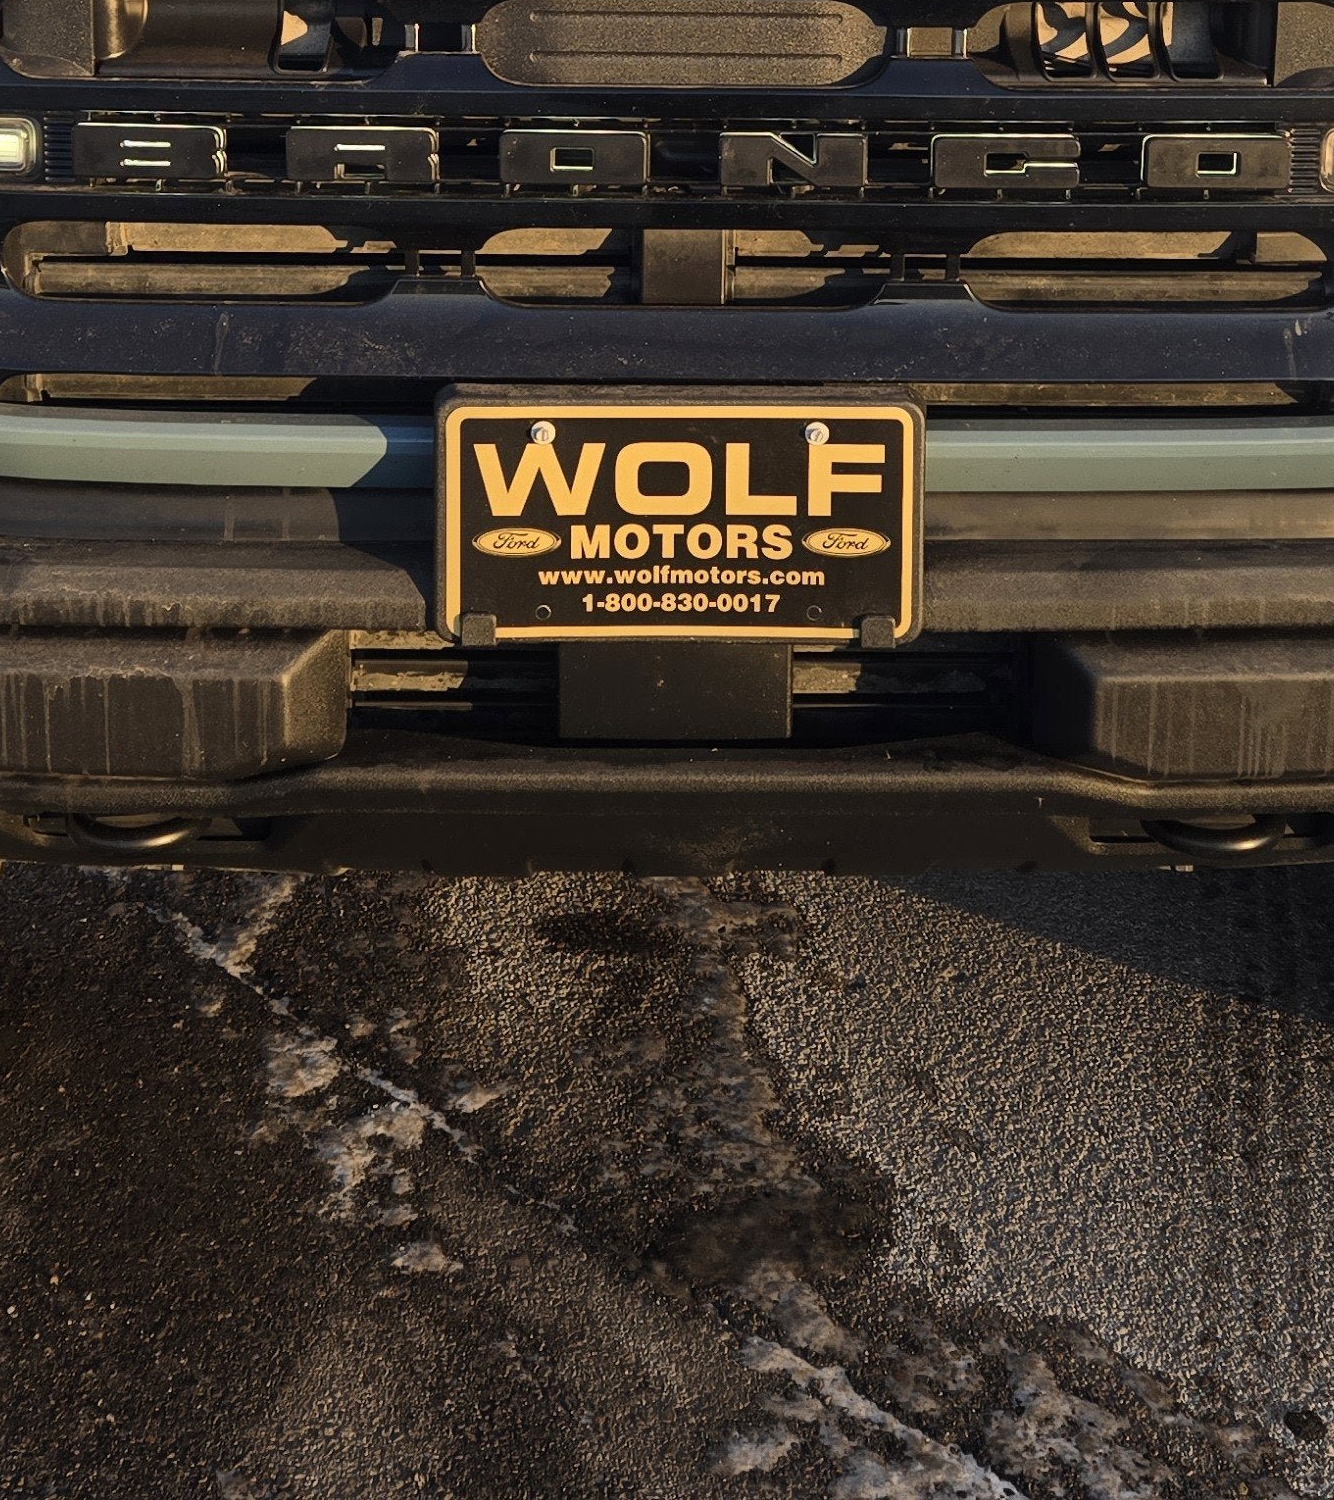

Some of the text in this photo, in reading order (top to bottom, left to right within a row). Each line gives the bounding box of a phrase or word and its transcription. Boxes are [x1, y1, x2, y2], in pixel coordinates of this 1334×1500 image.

[72, 122, 1291, 192] BRONCO
[473, 441, 886, 517] WOLF
[492, 531, 541, 550] Ford
[569, 522, 794, 561] MOTORS
[822, 531, 870, 550] Ford
[538, 565, 825, 587] www.wolfmotors.com
[581, 592, 781, 614] 1-800-830-0017
